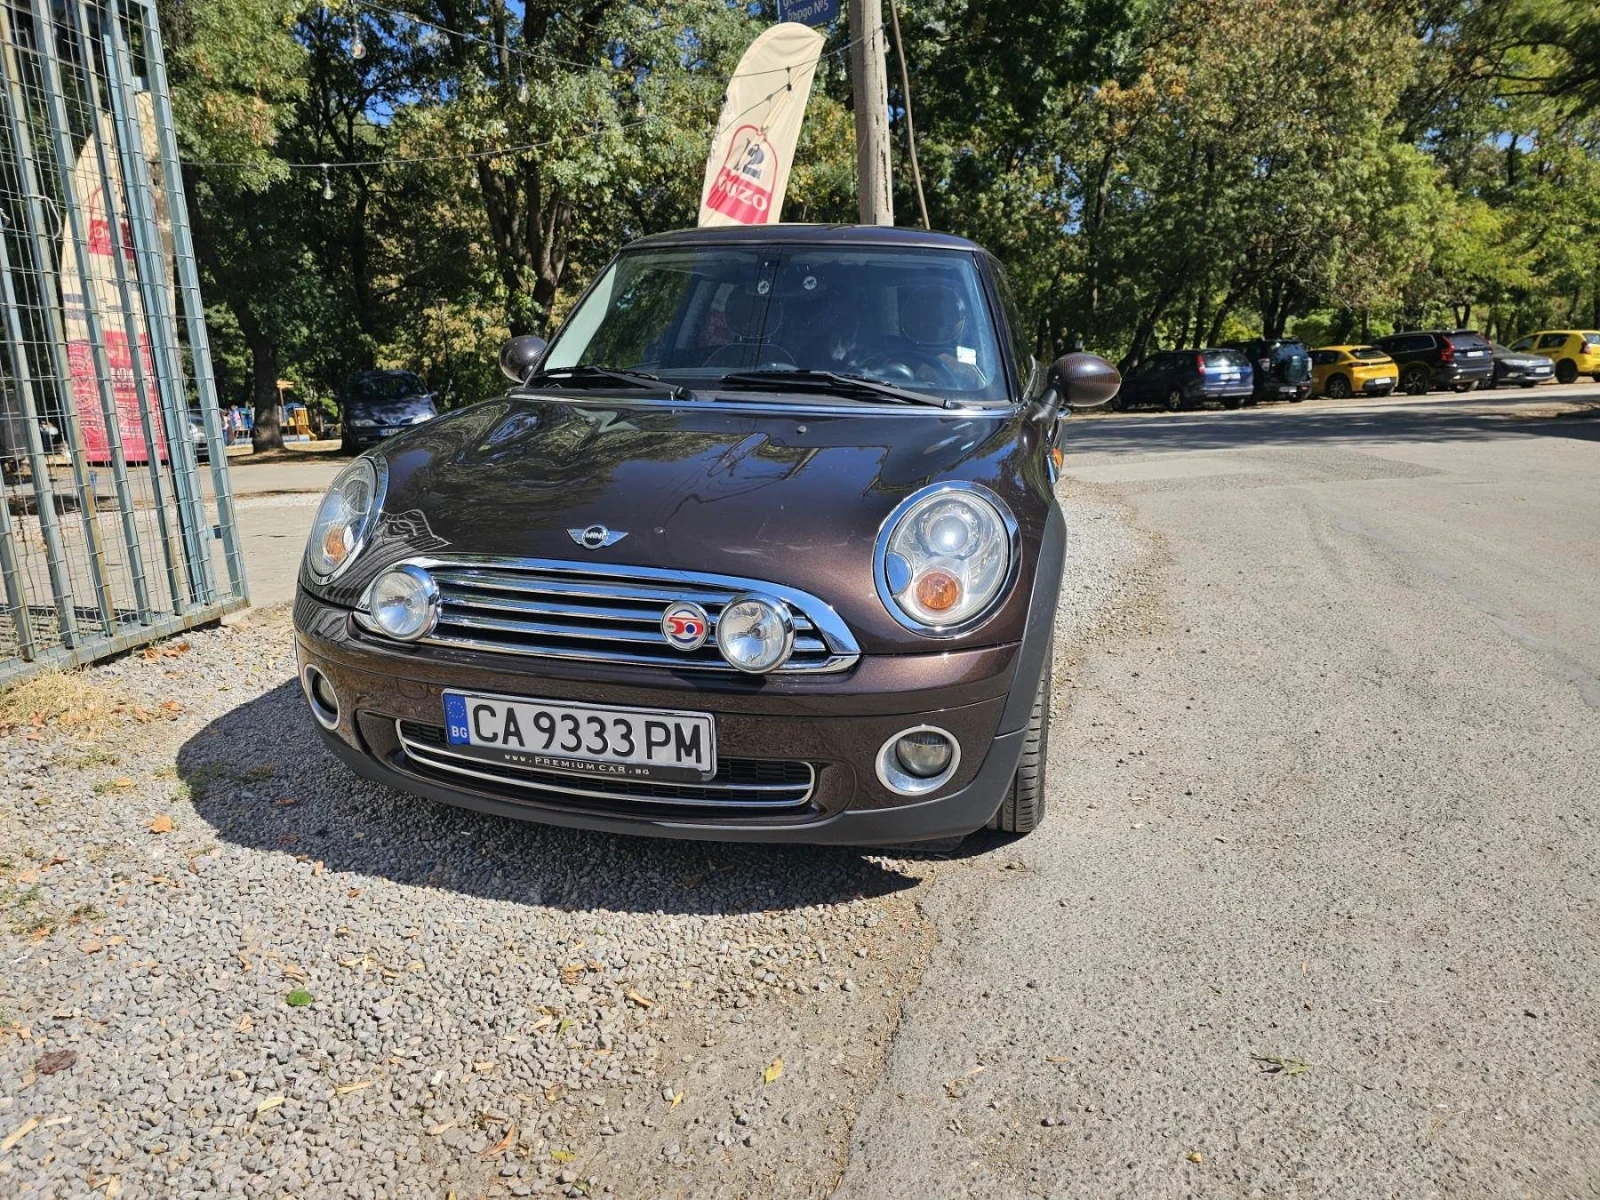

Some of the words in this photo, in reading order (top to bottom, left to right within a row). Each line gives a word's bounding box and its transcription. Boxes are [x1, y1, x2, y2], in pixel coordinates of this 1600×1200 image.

[585, 531, 604, 540] MINI
[451, 726, 468, 738] BG
[473, 704, 525, 747] CA
[533, 711, 635, 757] 9333
[645, 720, 702, 764] PM
